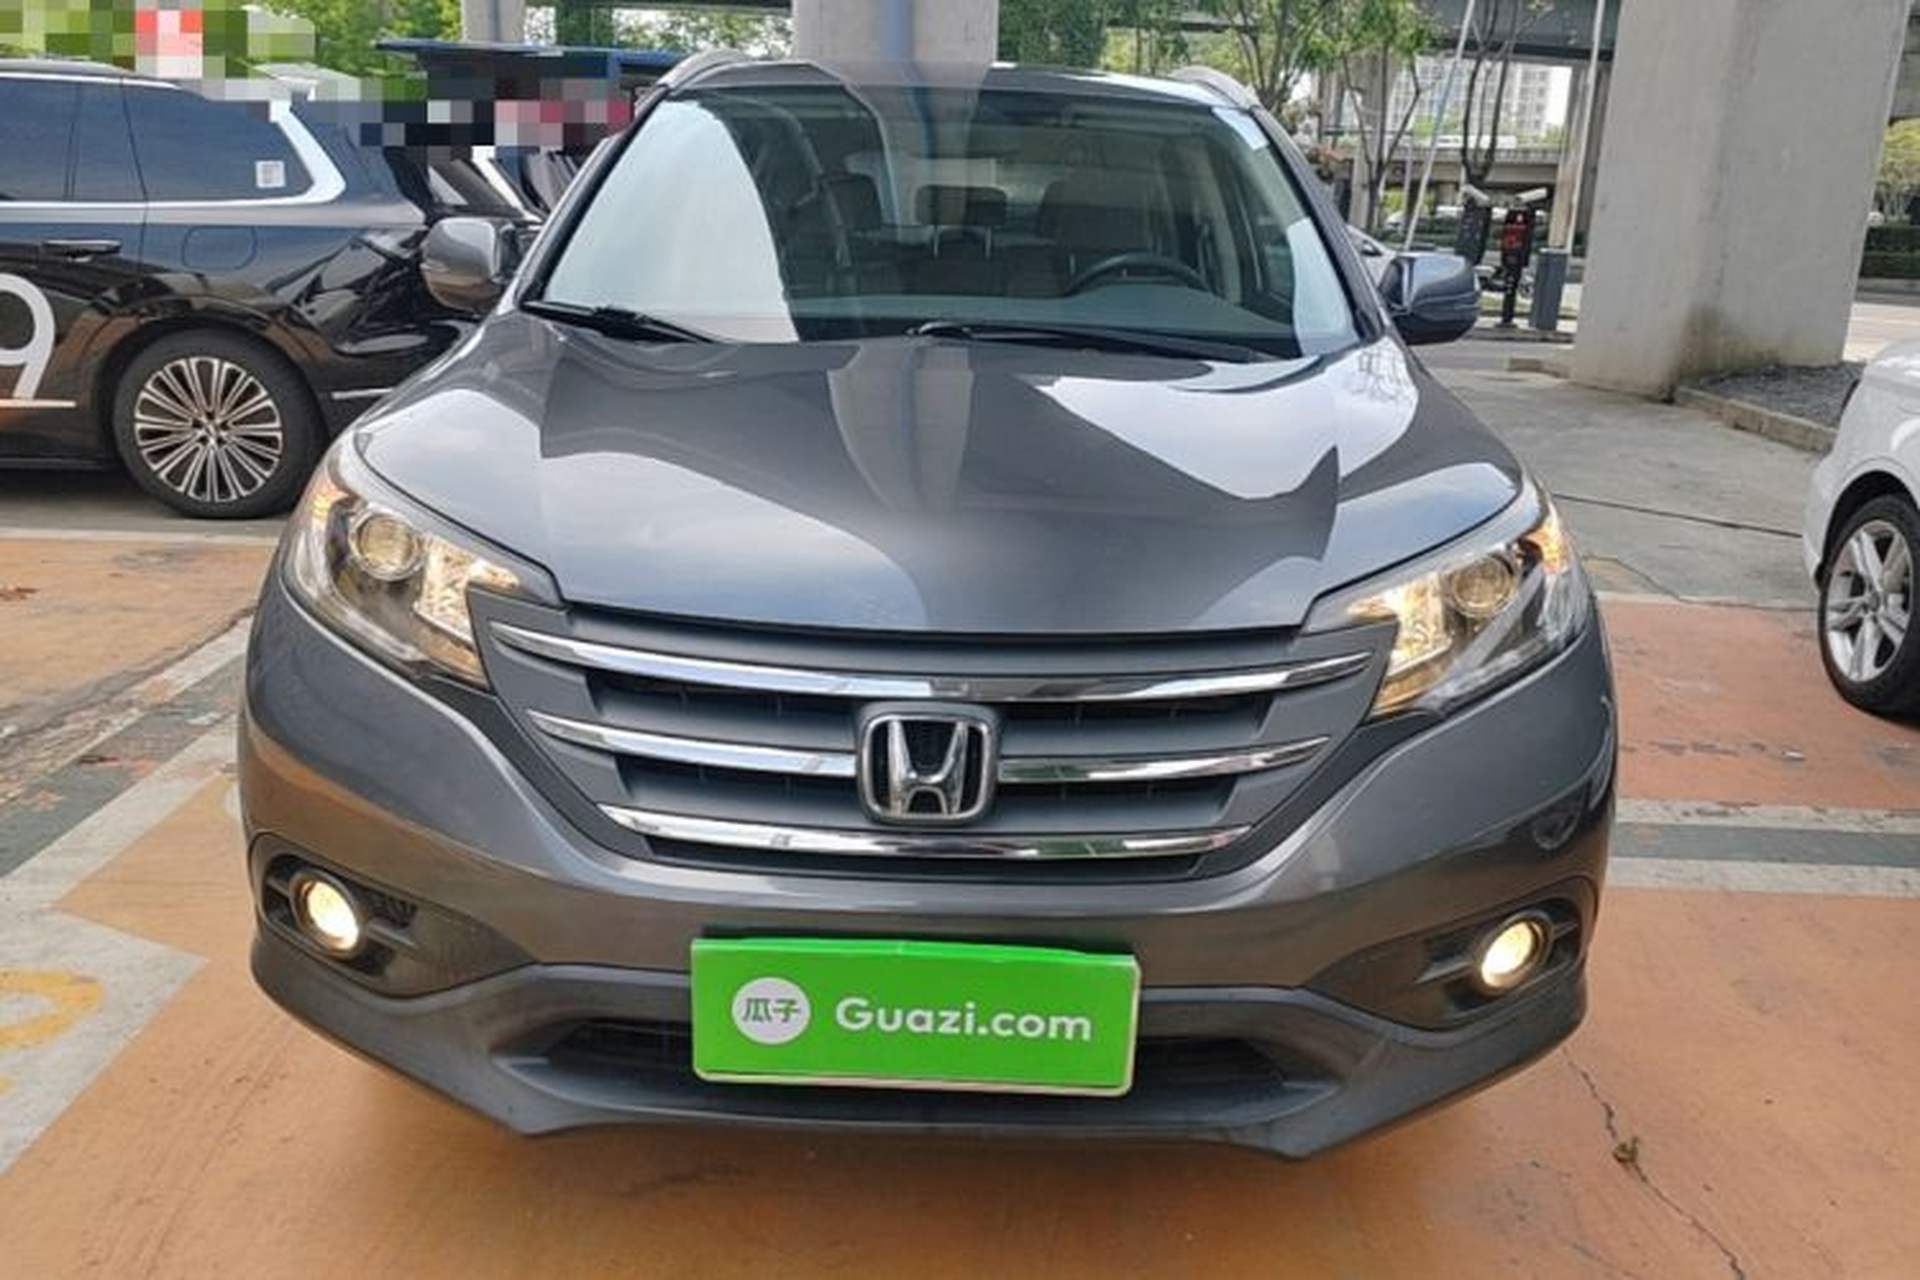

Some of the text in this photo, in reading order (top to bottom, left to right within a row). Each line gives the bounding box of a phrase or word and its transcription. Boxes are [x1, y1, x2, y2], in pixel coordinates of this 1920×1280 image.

[0, 273, 55, 400] 9
[742, 996, 801, 1024] 瓜子
[834, 996, 1093, 1041] Guazi.com
